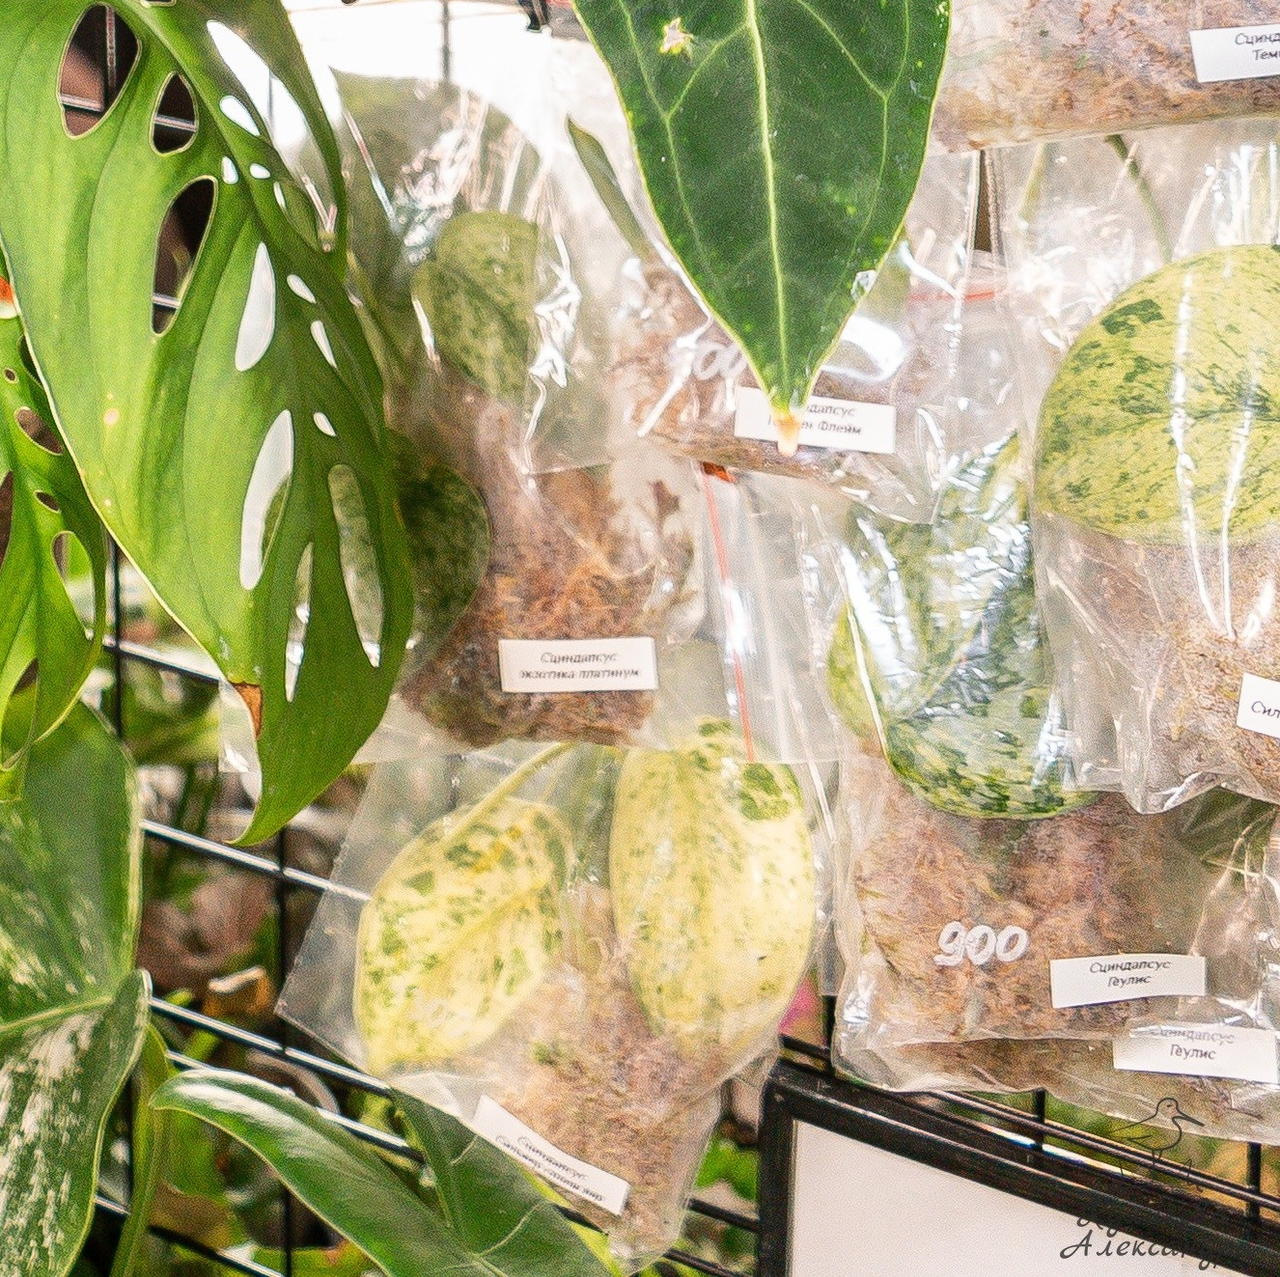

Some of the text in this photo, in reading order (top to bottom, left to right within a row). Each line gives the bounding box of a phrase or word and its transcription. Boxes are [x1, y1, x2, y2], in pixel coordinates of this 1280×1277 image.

[540, 651, 618, 664] Сциндапсус
[933, 921, 1029, 966] 900
[1089, 960, 1171, 974] Сциндапсус
